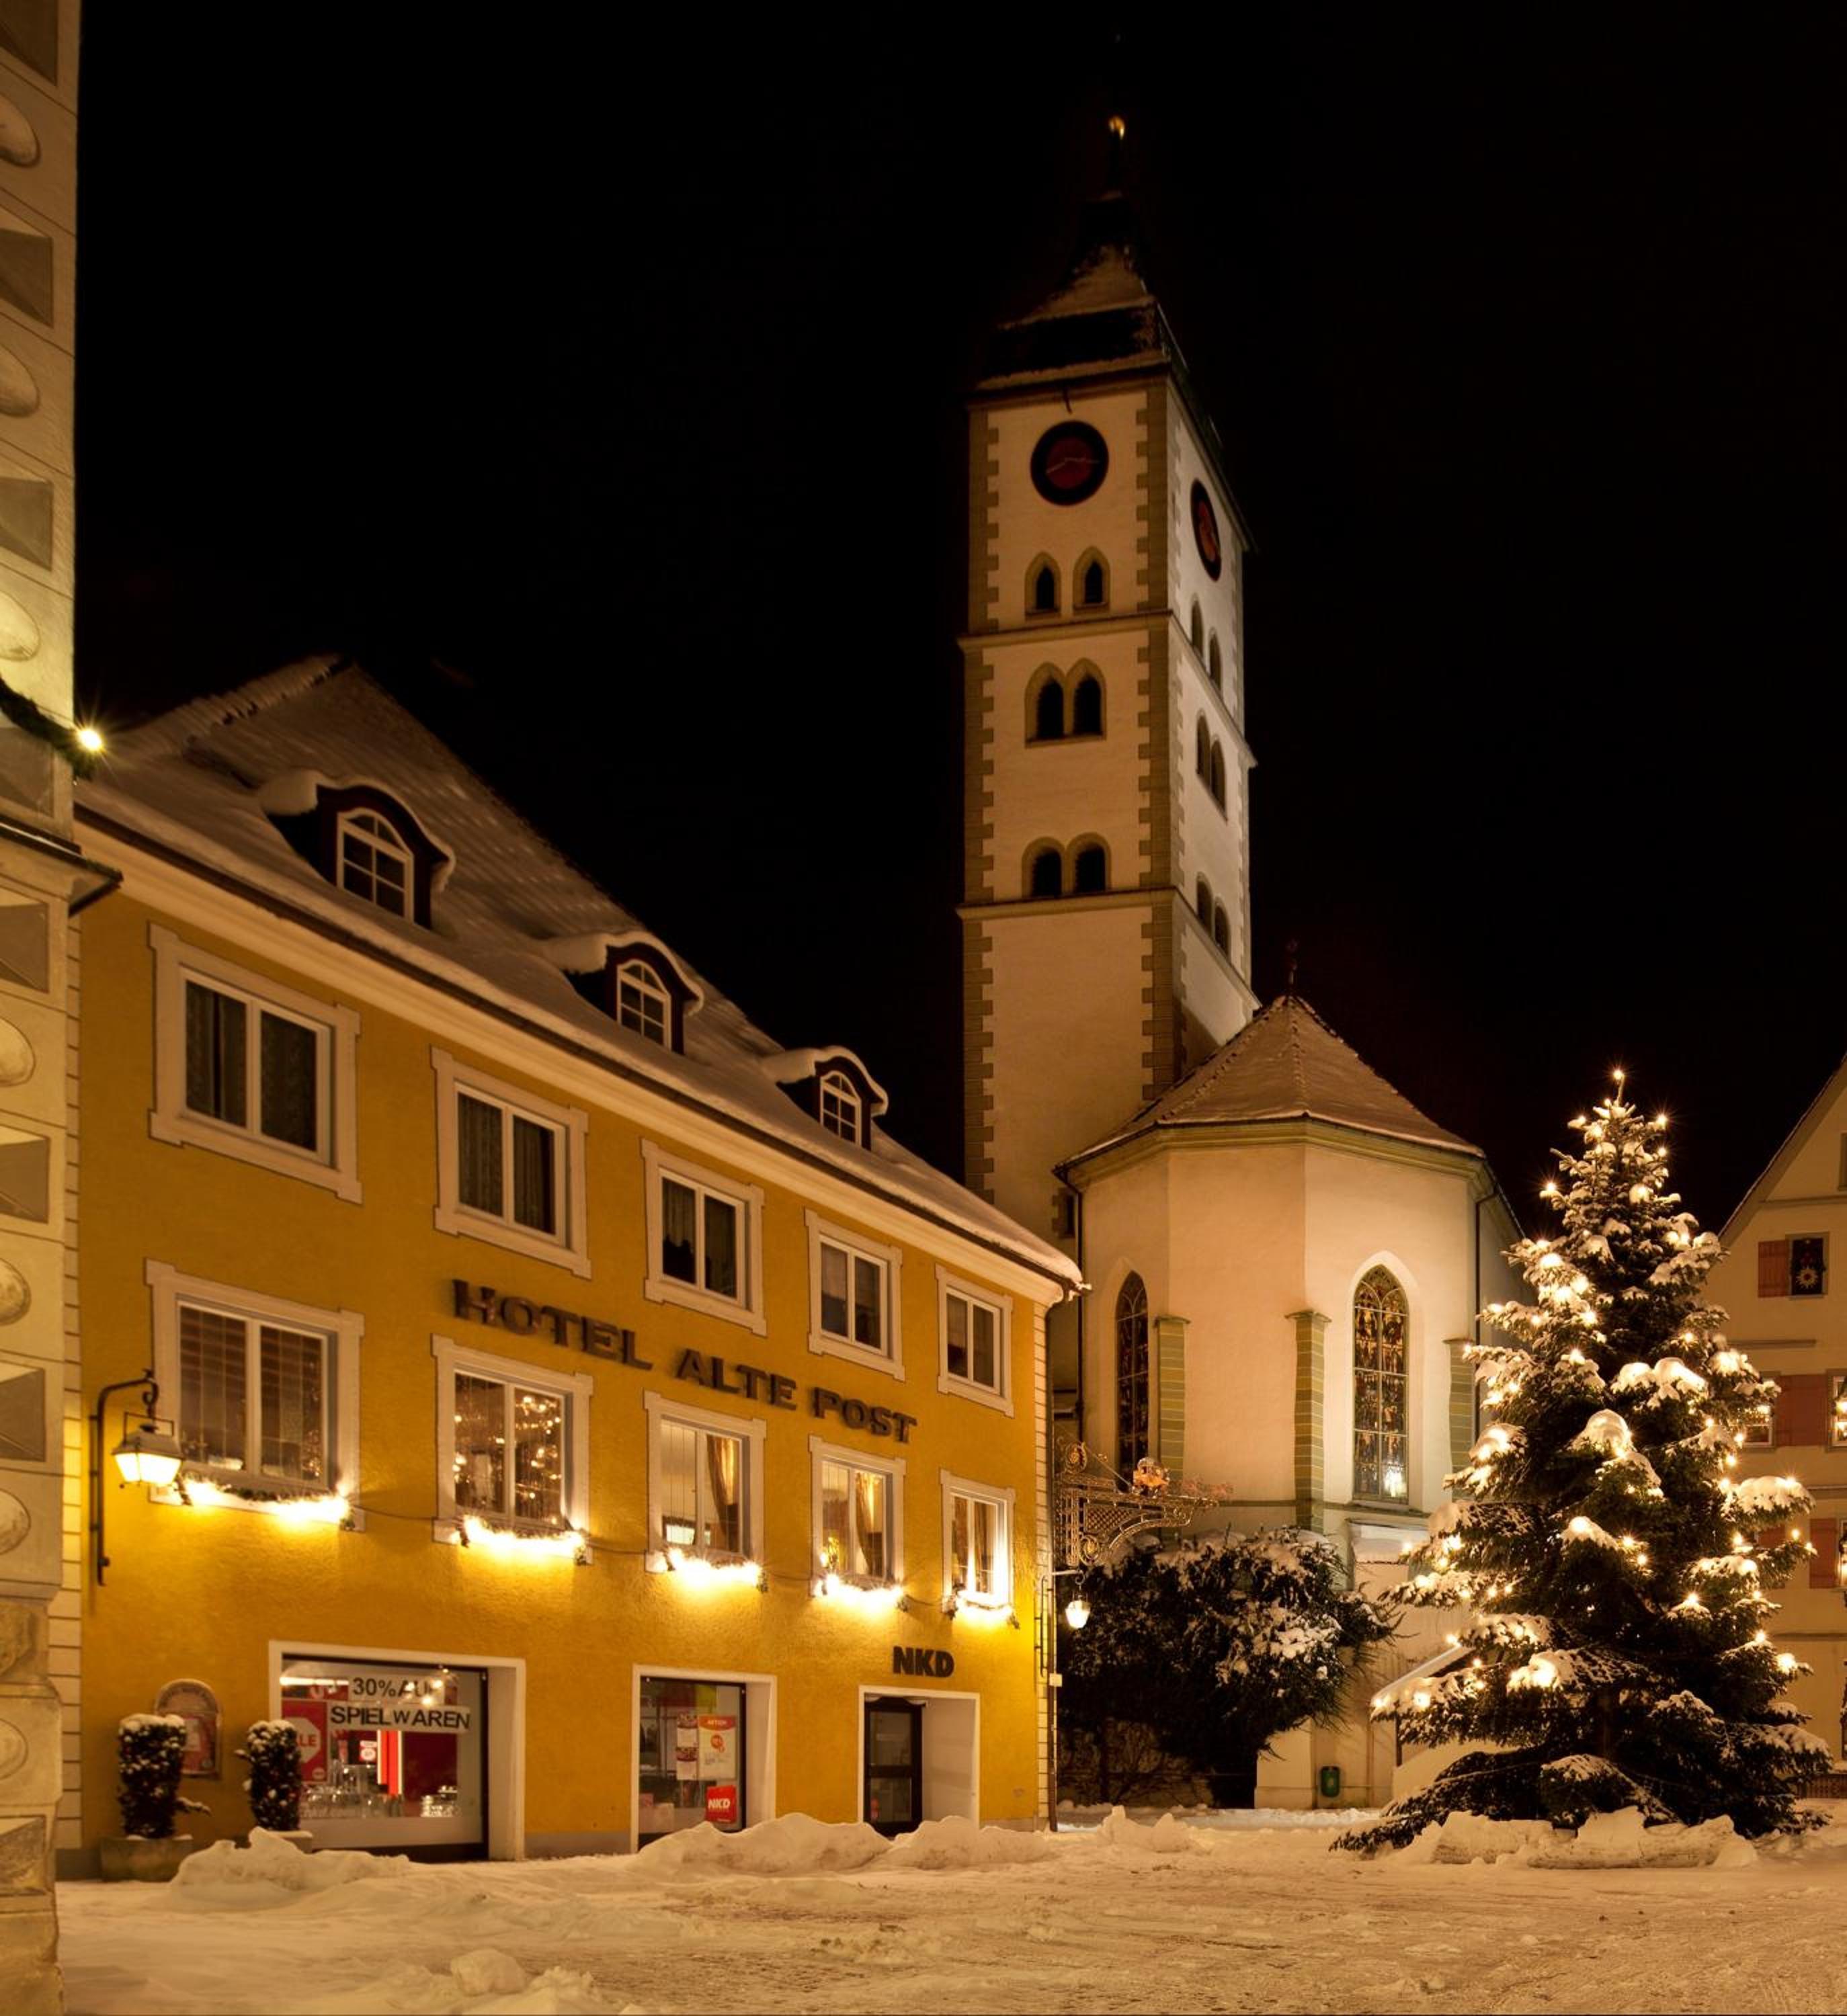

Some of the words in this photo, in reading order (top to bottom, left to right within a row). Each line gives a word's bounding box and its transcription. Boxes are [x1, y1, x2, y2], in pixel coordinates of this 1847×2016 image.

[450, 1278, 653, 1370] HOTEL
[675, 1349, 796, 1411] ALTE
[811, 1387, 918, 1444] POST
[893, 1646, 955, 1678] NKD
[331, 1706, 470, 1729] SPIELWAREN
[708, 1798, 731, 1808] NKD
